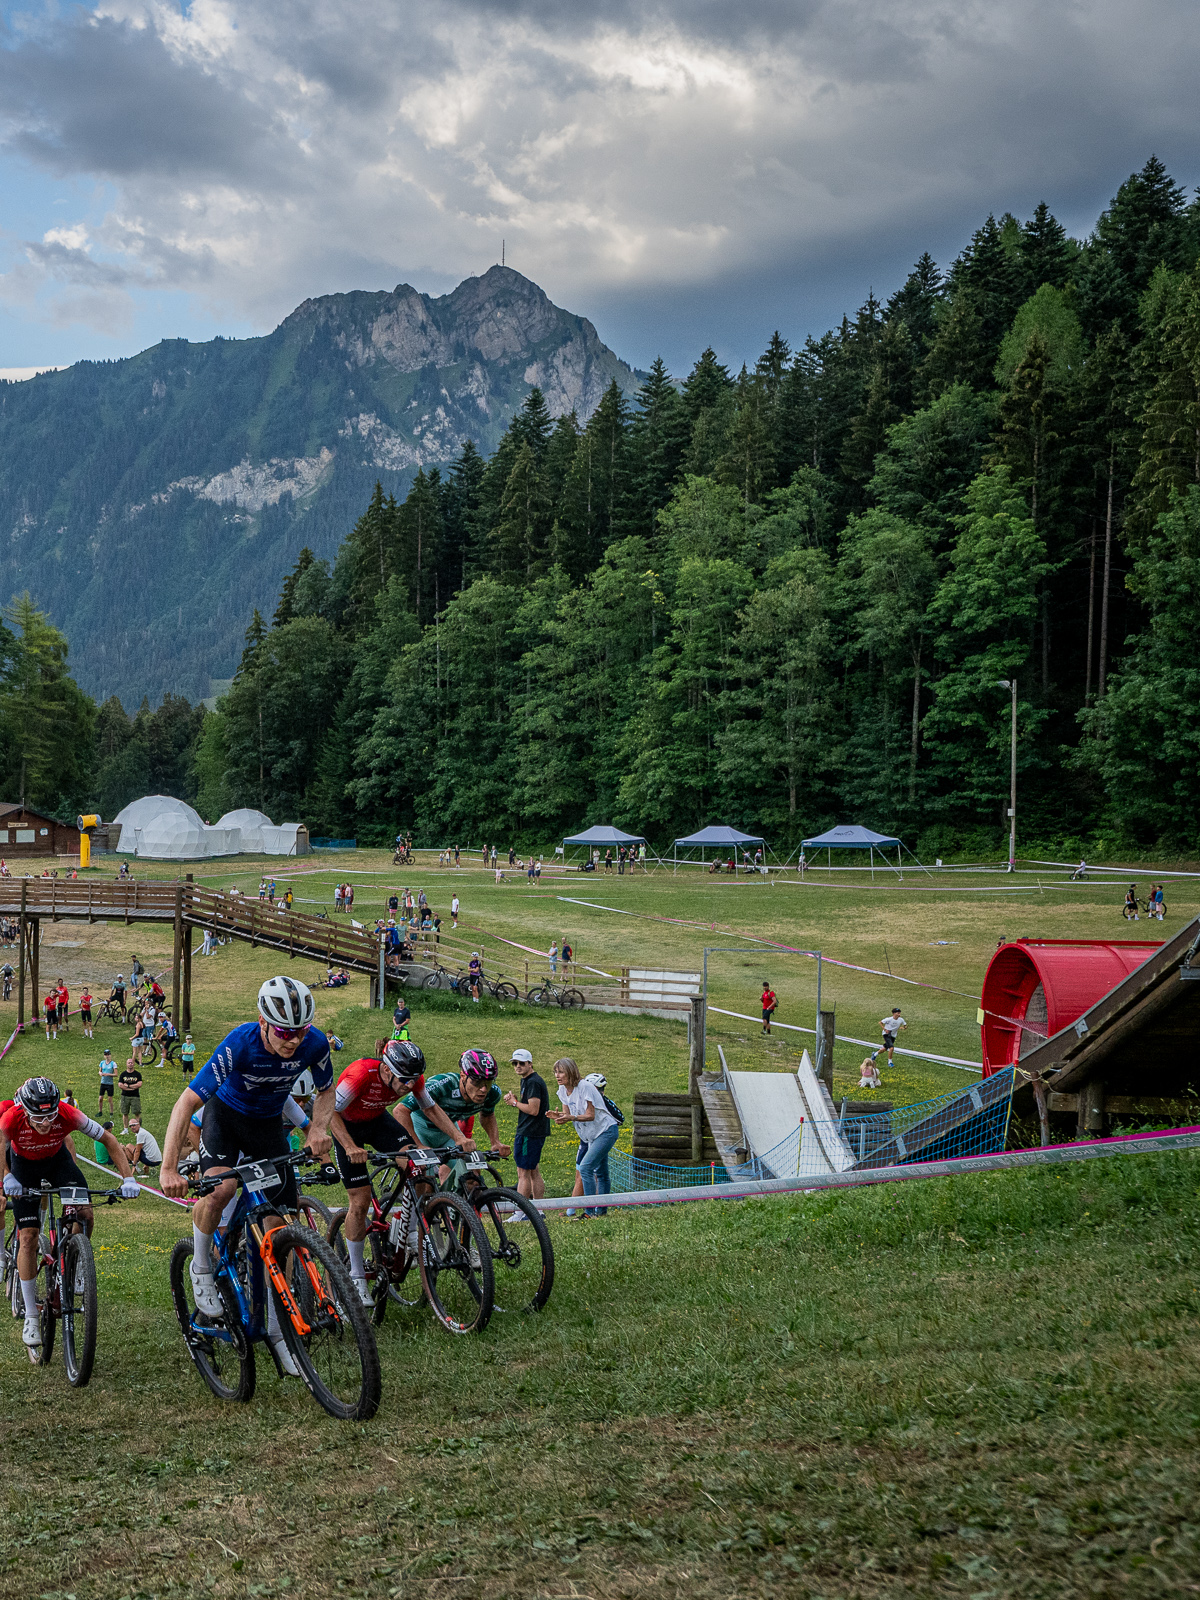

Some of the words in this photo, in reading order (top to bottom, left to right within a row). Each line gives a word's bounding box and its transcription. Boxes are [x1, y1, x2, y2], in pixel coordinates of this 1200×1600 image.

[416, 1149, 427, 1159] 8
[470, 1151, 480, 1162] 10
[248, 1163, 266, 1179] 3
[70, 1187, 77, 1198] 7
